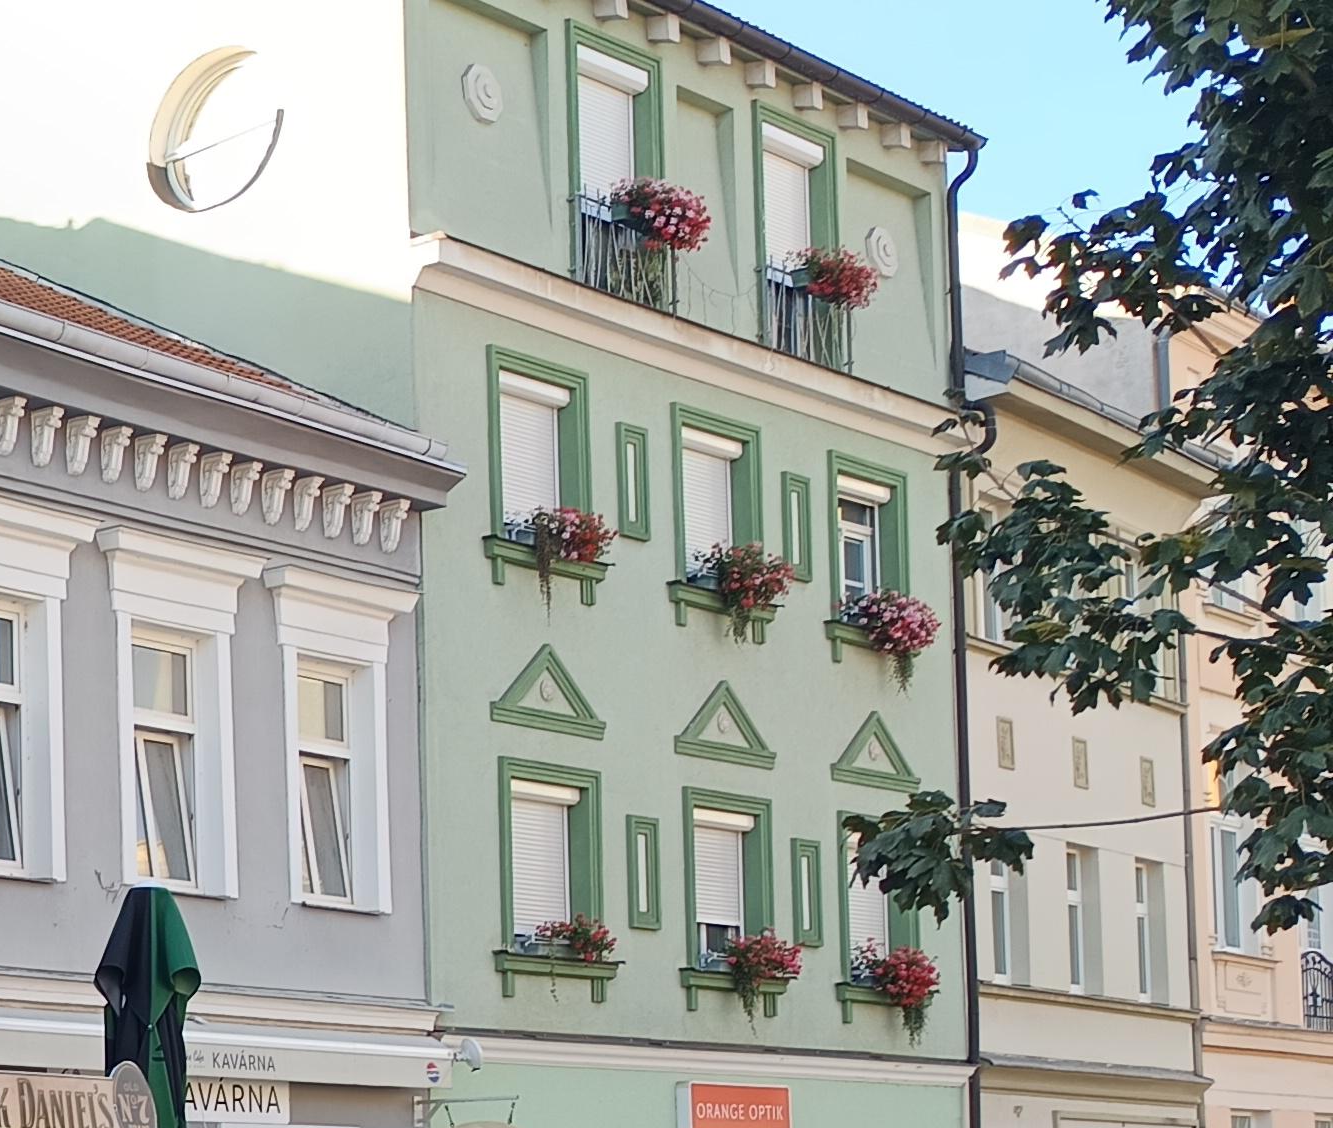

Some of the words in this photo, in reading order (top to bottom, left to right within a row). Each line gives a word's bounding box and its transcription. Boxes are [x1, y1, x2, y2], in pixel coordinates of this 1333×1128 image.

[212, 1050, 276, 1072] KAVÁRNA
[185, 1077, 281, 1114] AVÁRNA
[696, 1102, 745, 1120] ORANGE
[749, 1104, 784, 1121] OPTIK
